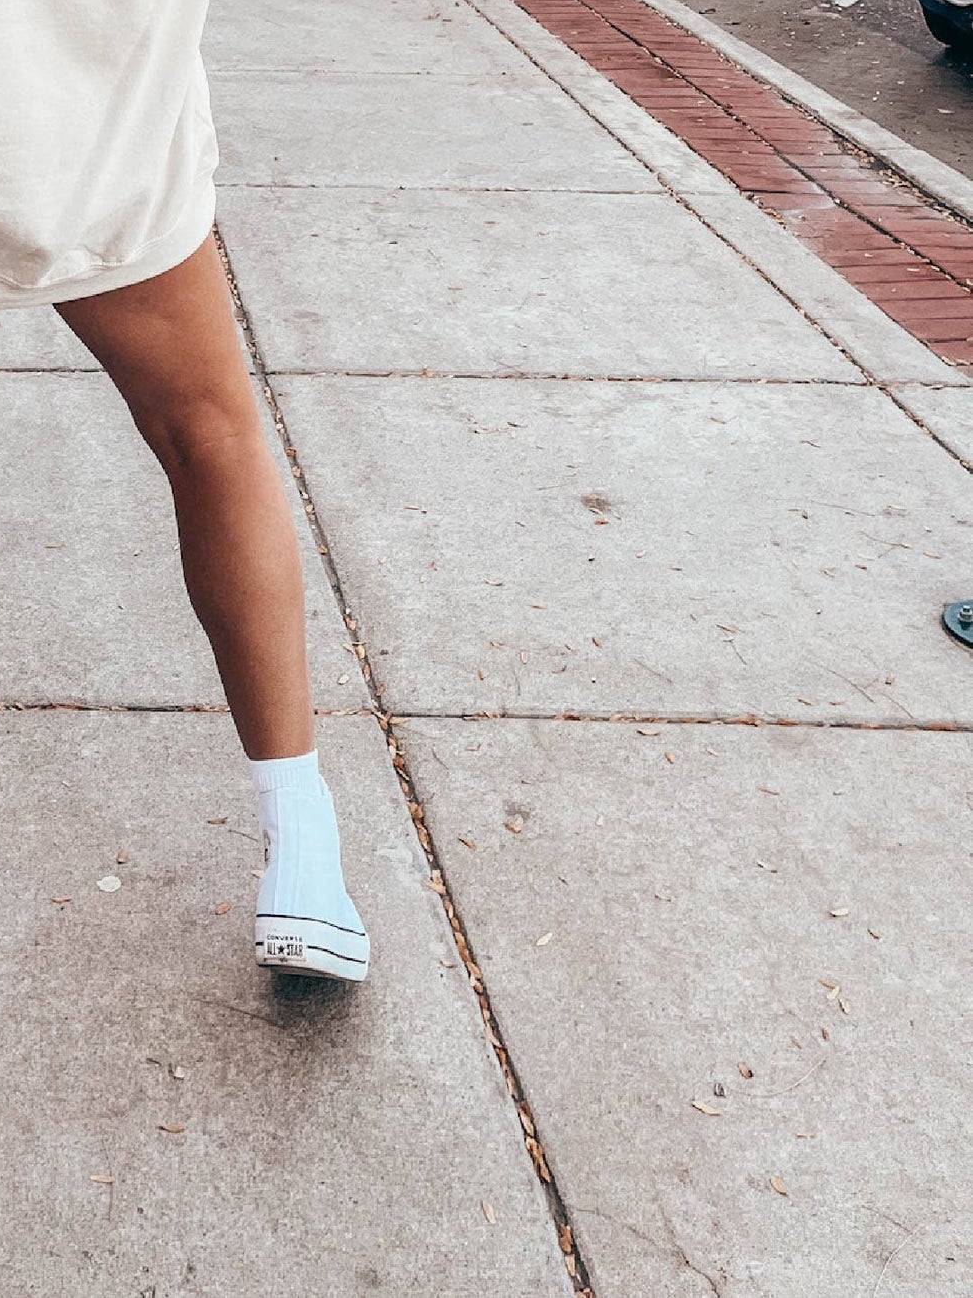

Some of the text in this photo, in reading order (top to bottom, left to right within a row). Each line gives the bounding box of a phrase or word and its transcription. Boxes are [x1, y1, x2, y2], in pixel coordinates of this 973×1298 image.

[267, 933, 303, 942] CONVERSE
[267, 942, 304, 956] ALL STAR
